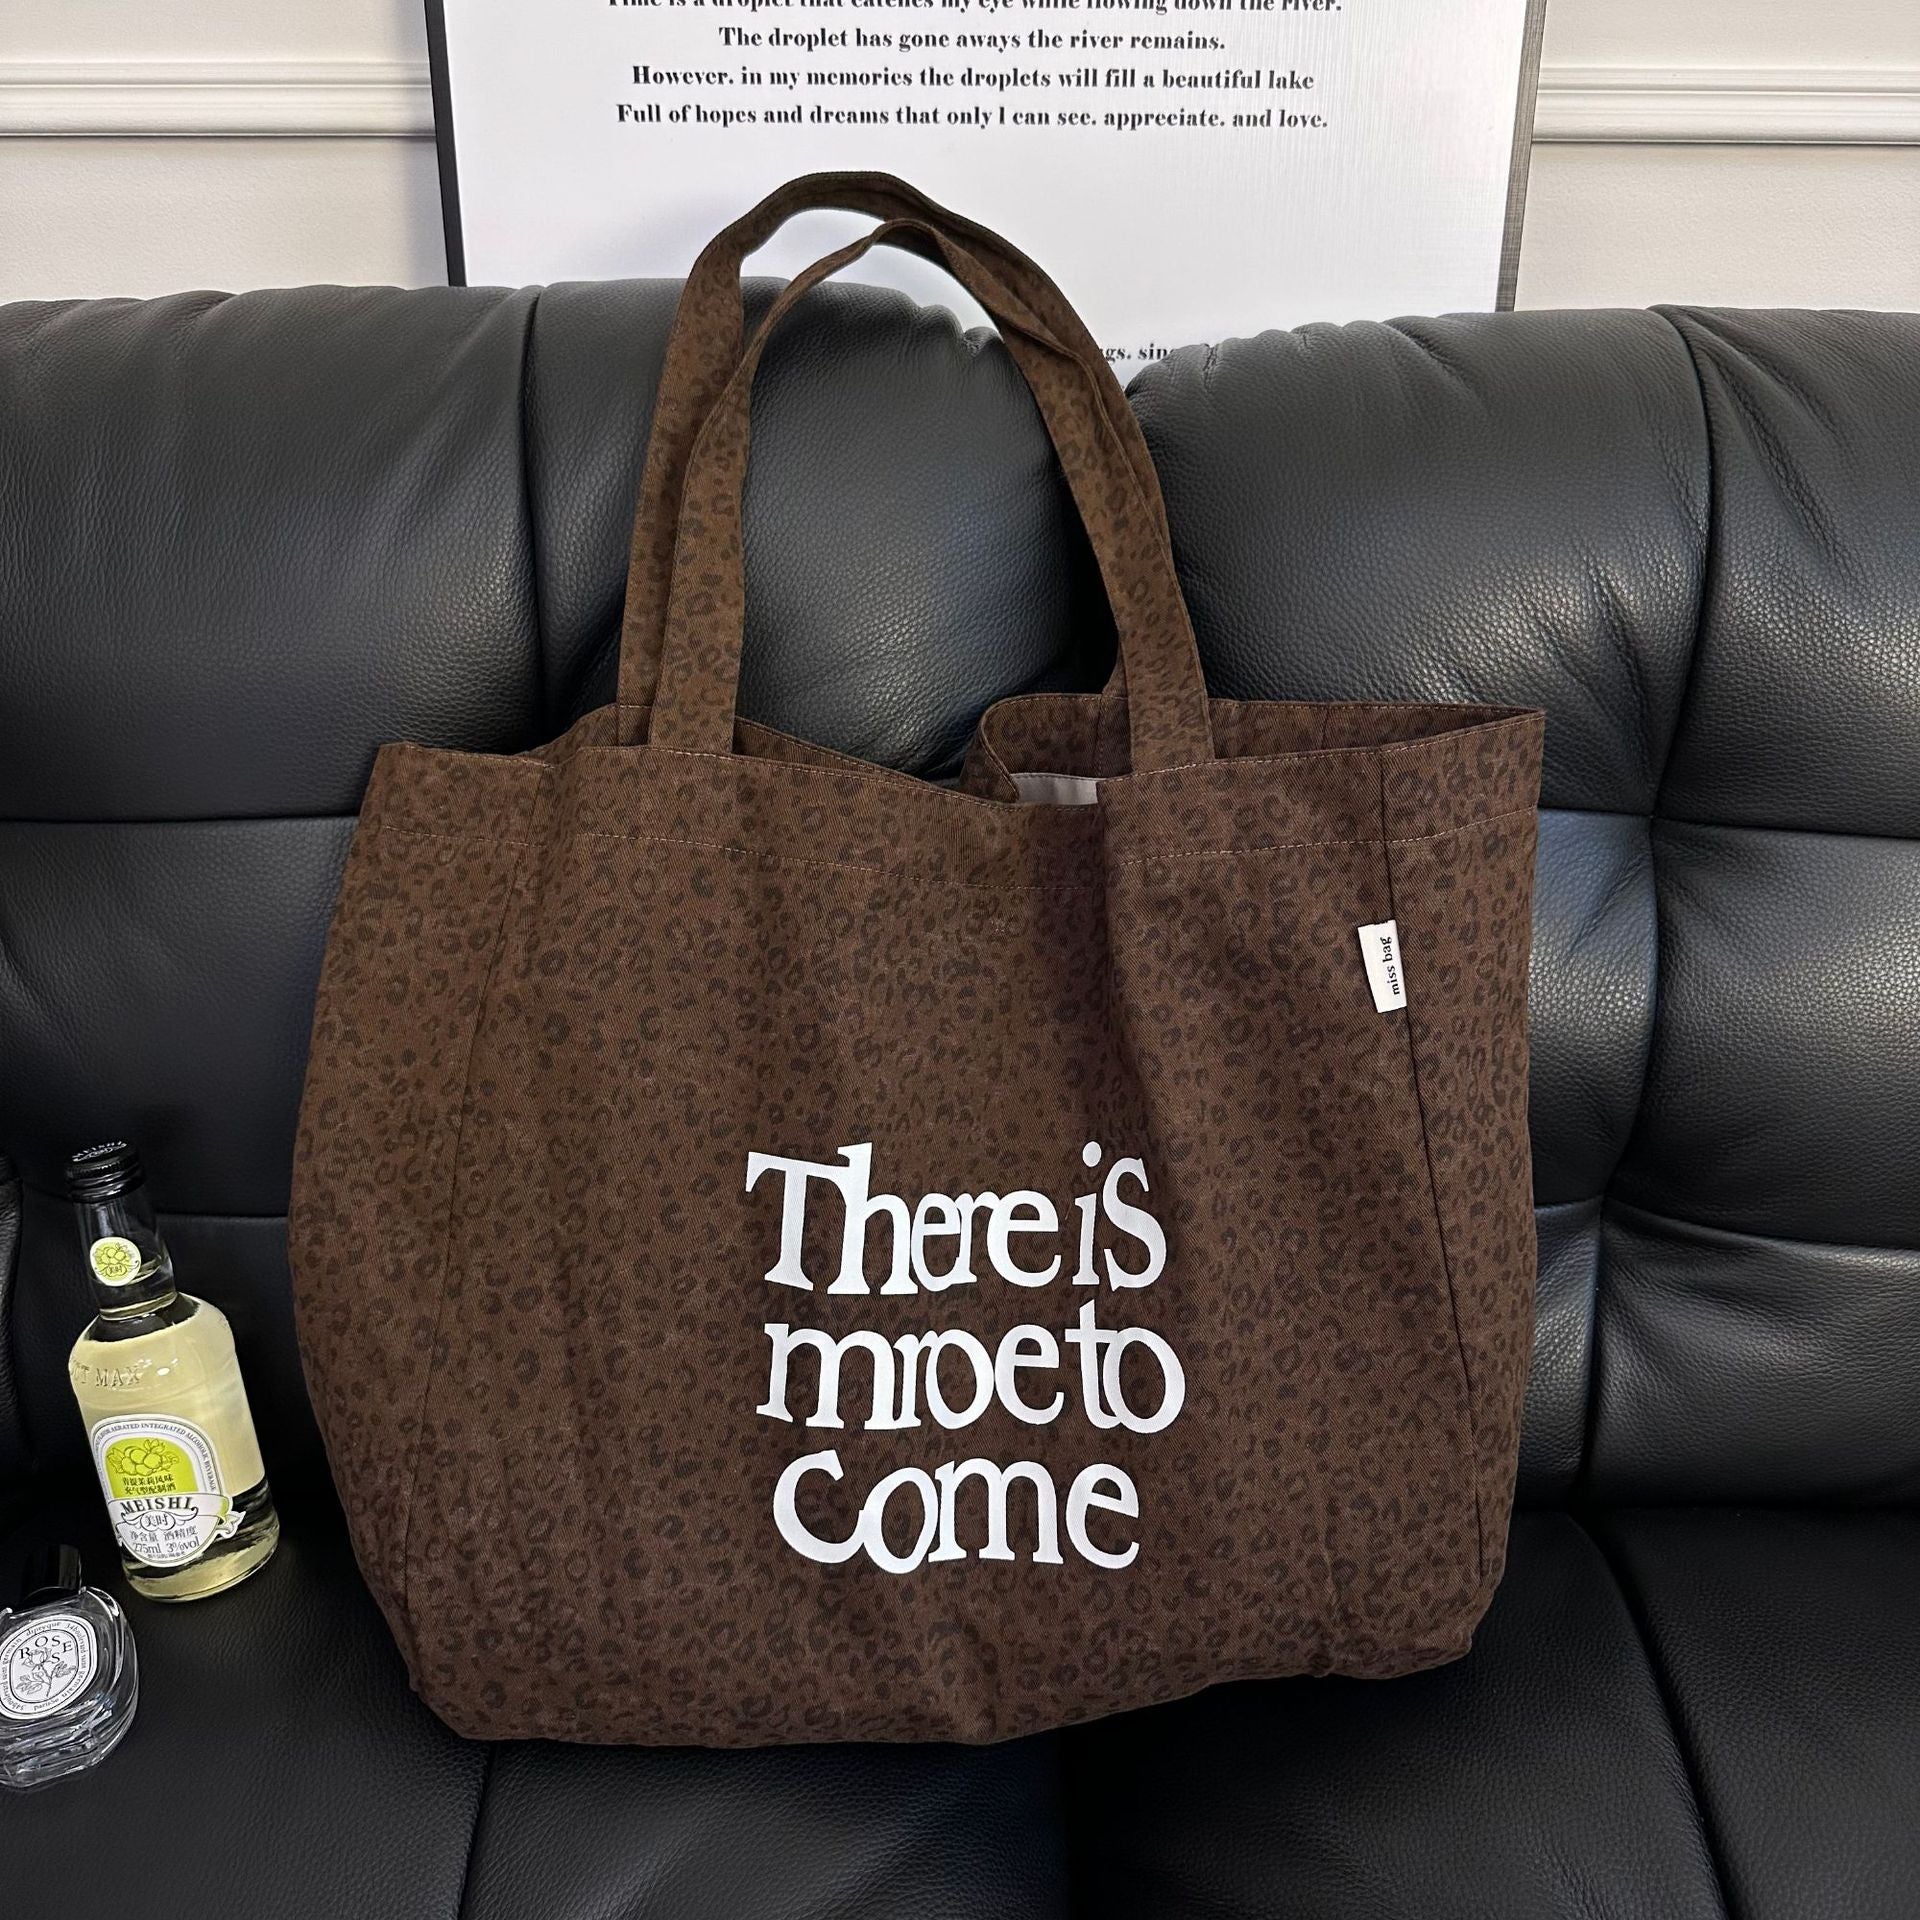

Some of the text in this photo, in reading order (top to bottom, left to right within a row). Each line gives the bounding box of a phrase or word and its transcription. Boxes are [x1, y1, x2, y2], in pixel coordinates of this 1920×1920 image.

[718, 27, 1225, 53] The droplet has gone aways the river remains.
[741, 66, 762, 85] in
[770, 72, 800, 90] my
[807, 66, 913, 86] memories
[920, 67, 954, 86] the
[960, 67, 1051, 92] droplets
[1058, 68, 1098, 87] will
[1105, 68, 1136, 87] fill
[1143, 75, 1155, 88] a
[1163, 69, 1261, 89] beautiful
[1269, 70, 1314, 89] lake
[617, 104, 661, 123] Full
[668, 104, 692, 123] of
[695, 104, 757, 128] hopes
[763, 105, 802, 123] and
[809, 105, 889, 124] dreams
[896, 105, 939, 124] that
[947, 106, 992, 129] only
[1012, 112, 1051, 125] can
[1232, 109, 1272, 127] and
[1279, 109, 1328, 128] love.
[1137, 342, 1174, 360] sin
[1379, 936, 1401, 995] miss bag
[745, 1142, 1062, 1295] There
[756, 1299, 1186, 1434] mroe to
[120, 1497, 193, 1514] MEISHI
